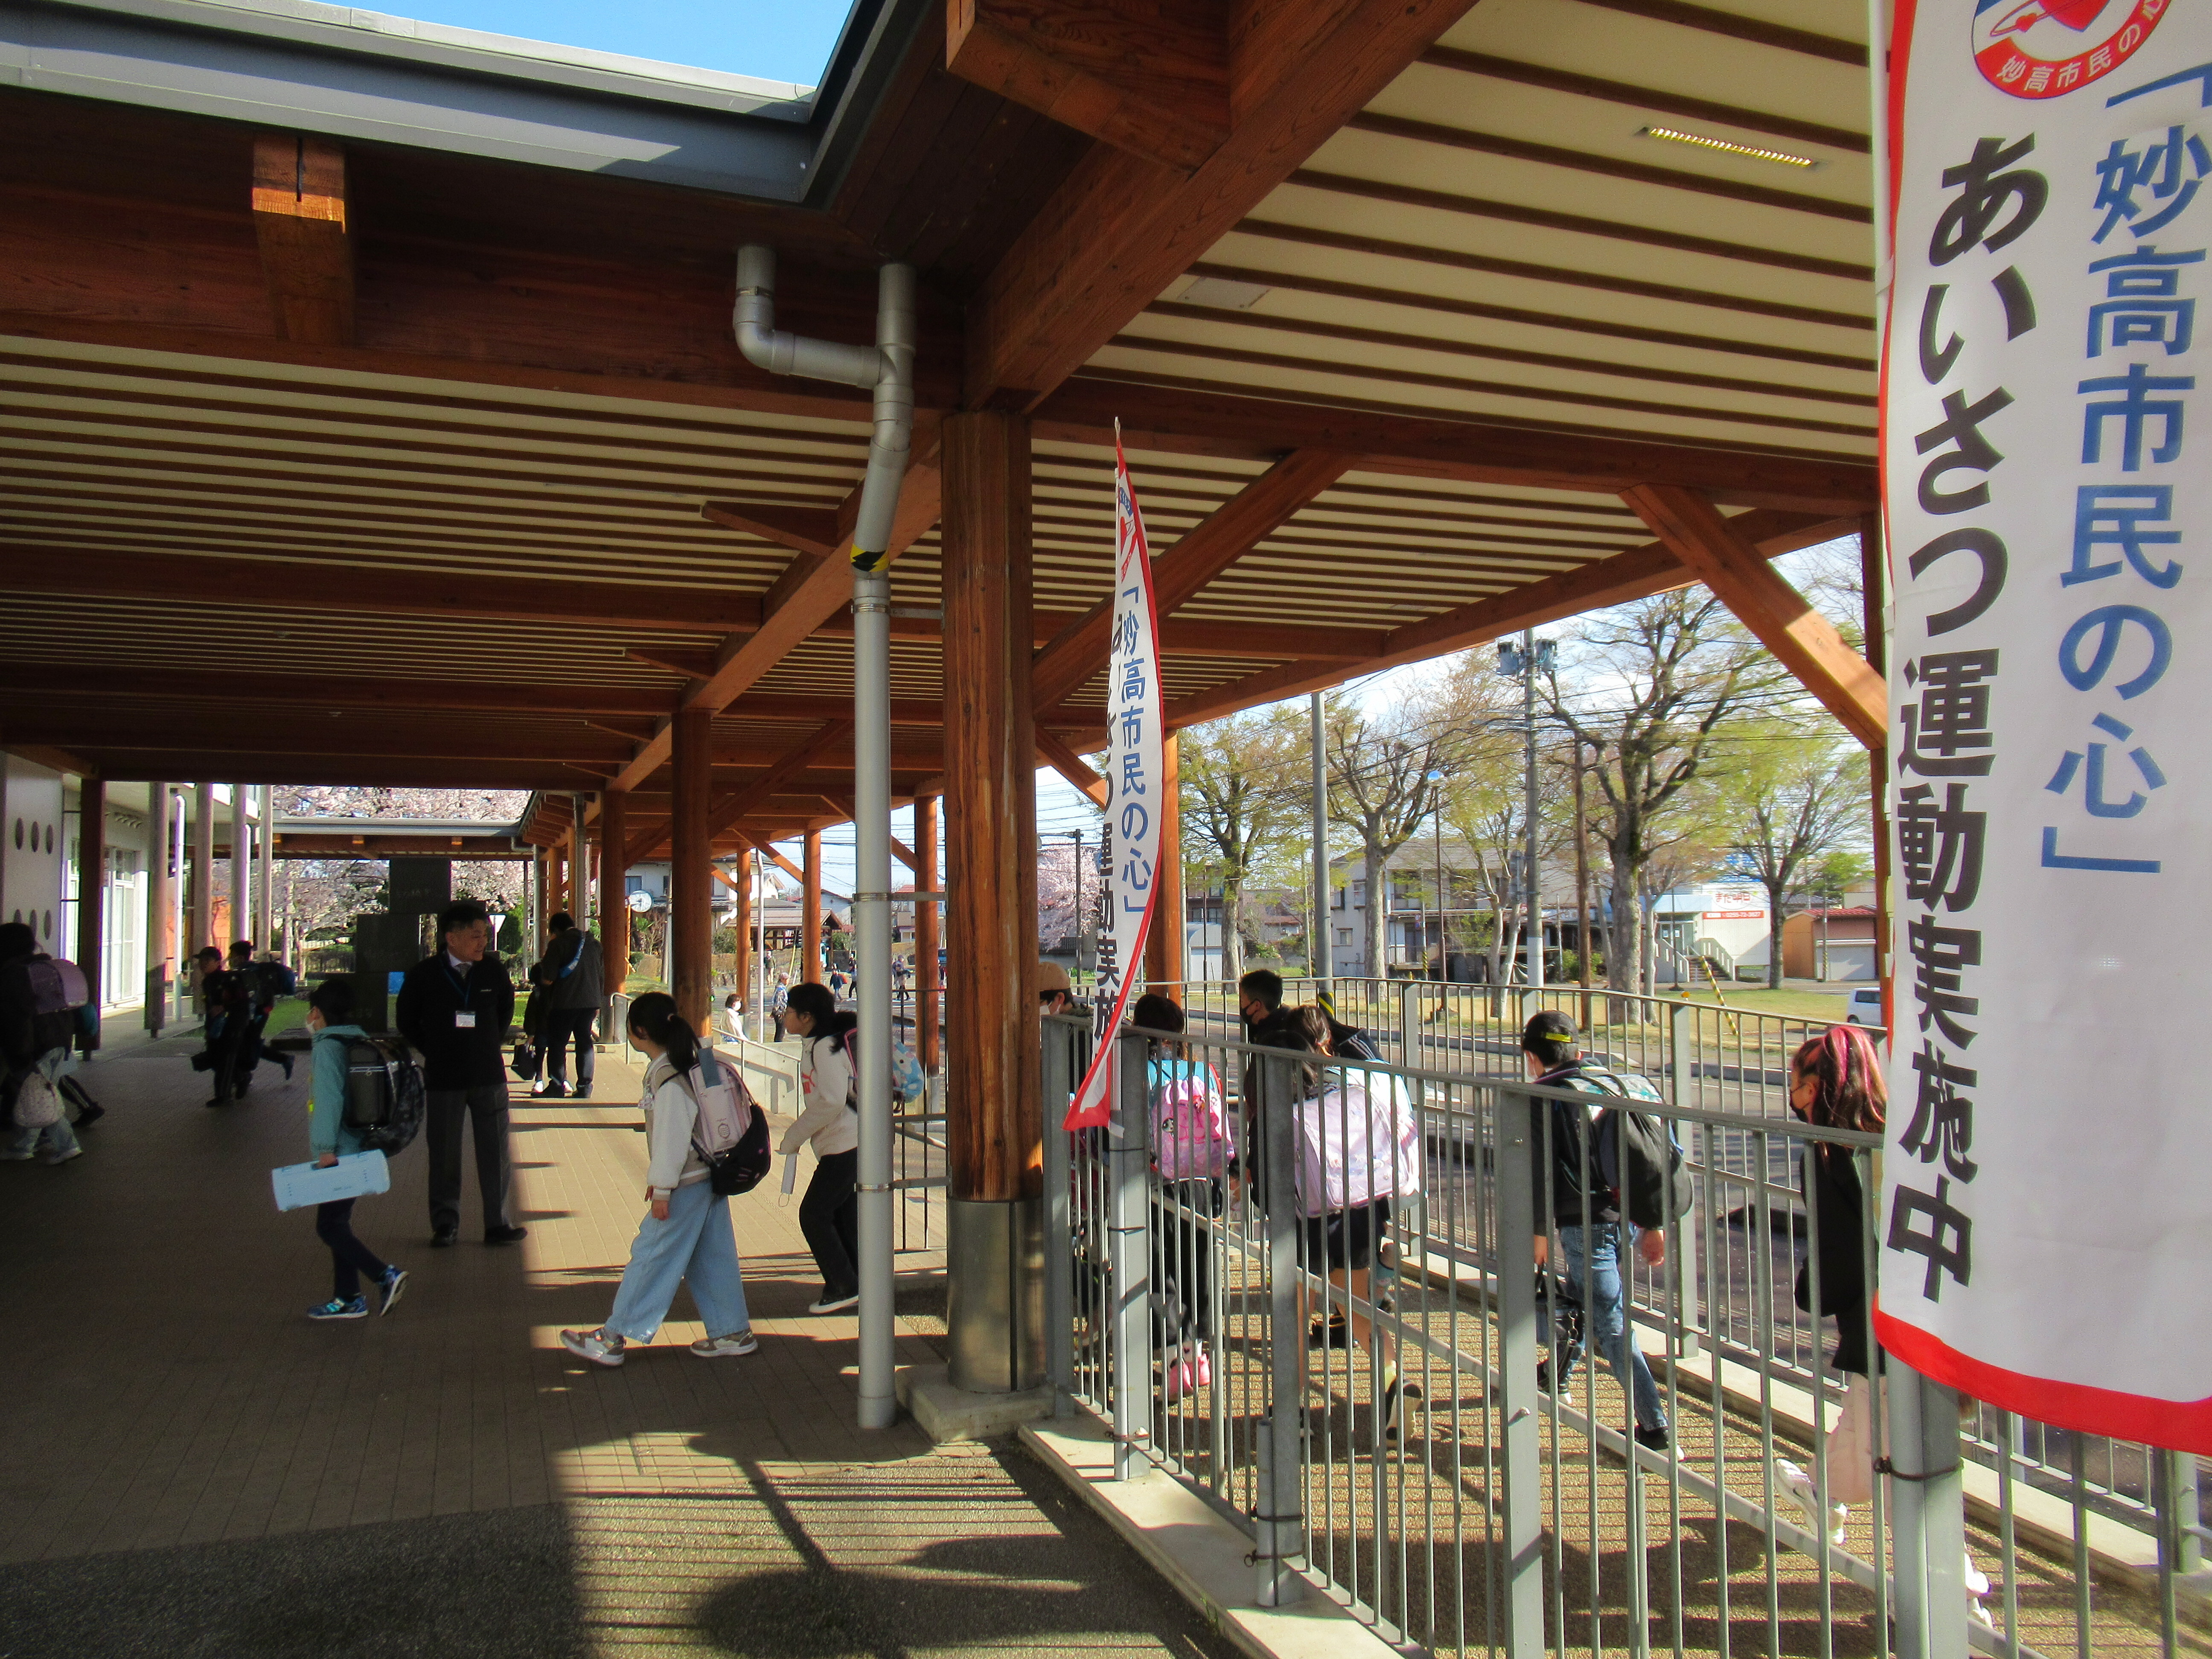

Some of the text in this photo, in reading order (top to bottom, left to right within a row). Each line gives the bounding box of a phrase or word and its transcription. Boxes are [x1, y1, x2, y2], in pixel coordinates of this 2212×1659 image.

[1887, 131, 2049, 1304] あいさつ運動実施中
[2041, 62, 2212, 873] 「妙高市民の心」
[1715, 892, 1750, 903] また明日
